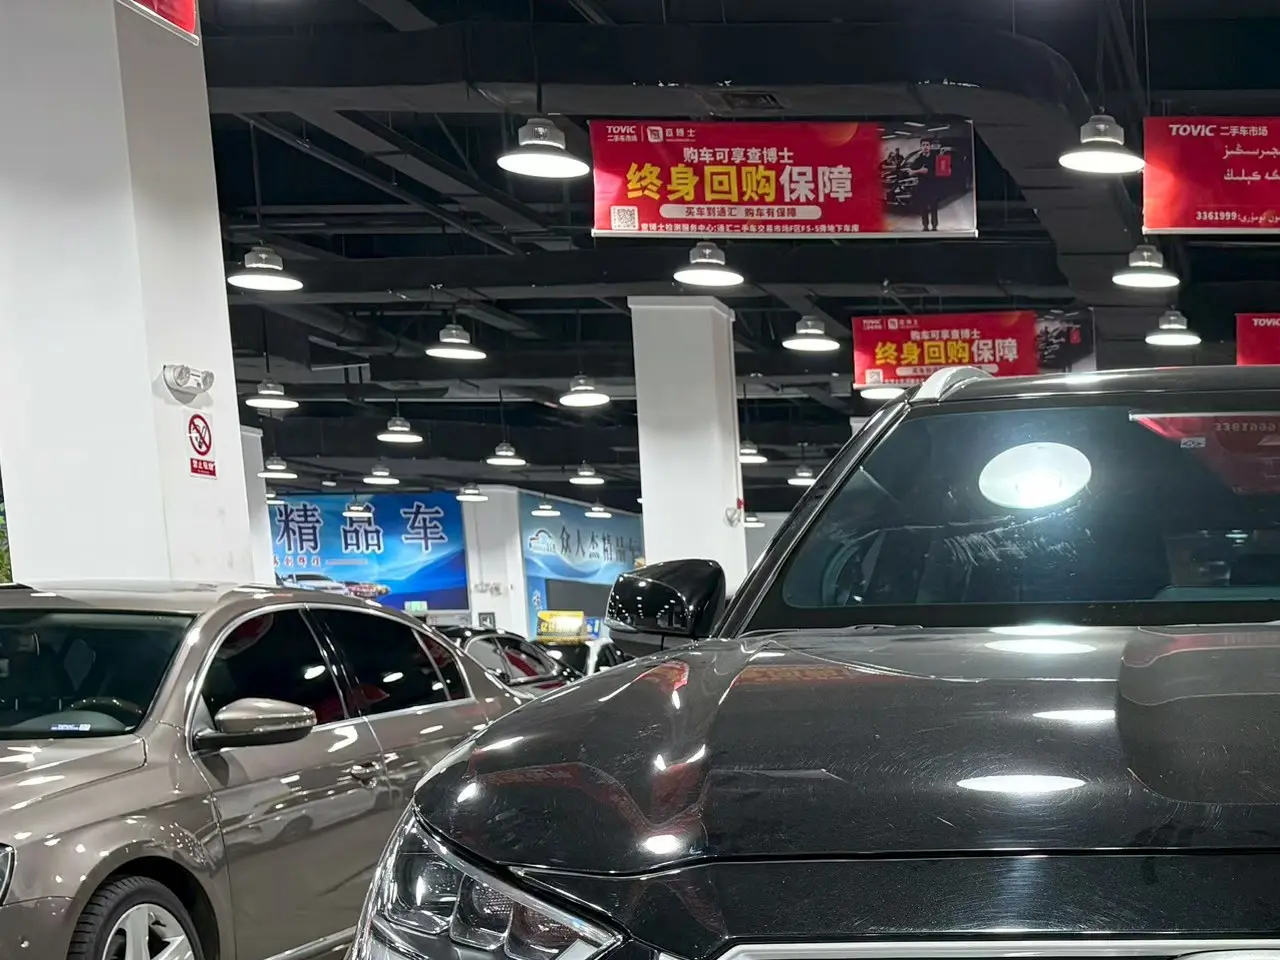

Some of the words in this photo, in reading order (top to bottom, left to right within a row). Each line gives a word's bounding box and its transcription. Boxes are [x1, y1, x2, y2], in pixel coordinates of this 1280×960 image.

[606, 125, 637, 134] TOVIC
[1168, 124, 1217, 136] TOVIC
[1220, 125, 1269, 137] 二手车市场
[683, 147, 795, 164] 购车可享查博士
[626, 162, 853, 204] 终身回购保障
[685, 206, 737, 217] 买车到通汇
[744, 207, 797, 218] 购车有保障
[1196, 211, 1237, 221] 3361999
[875, 337, 1019, 365] 终身回购保障
[275, 501, 448, 554] 精品车
